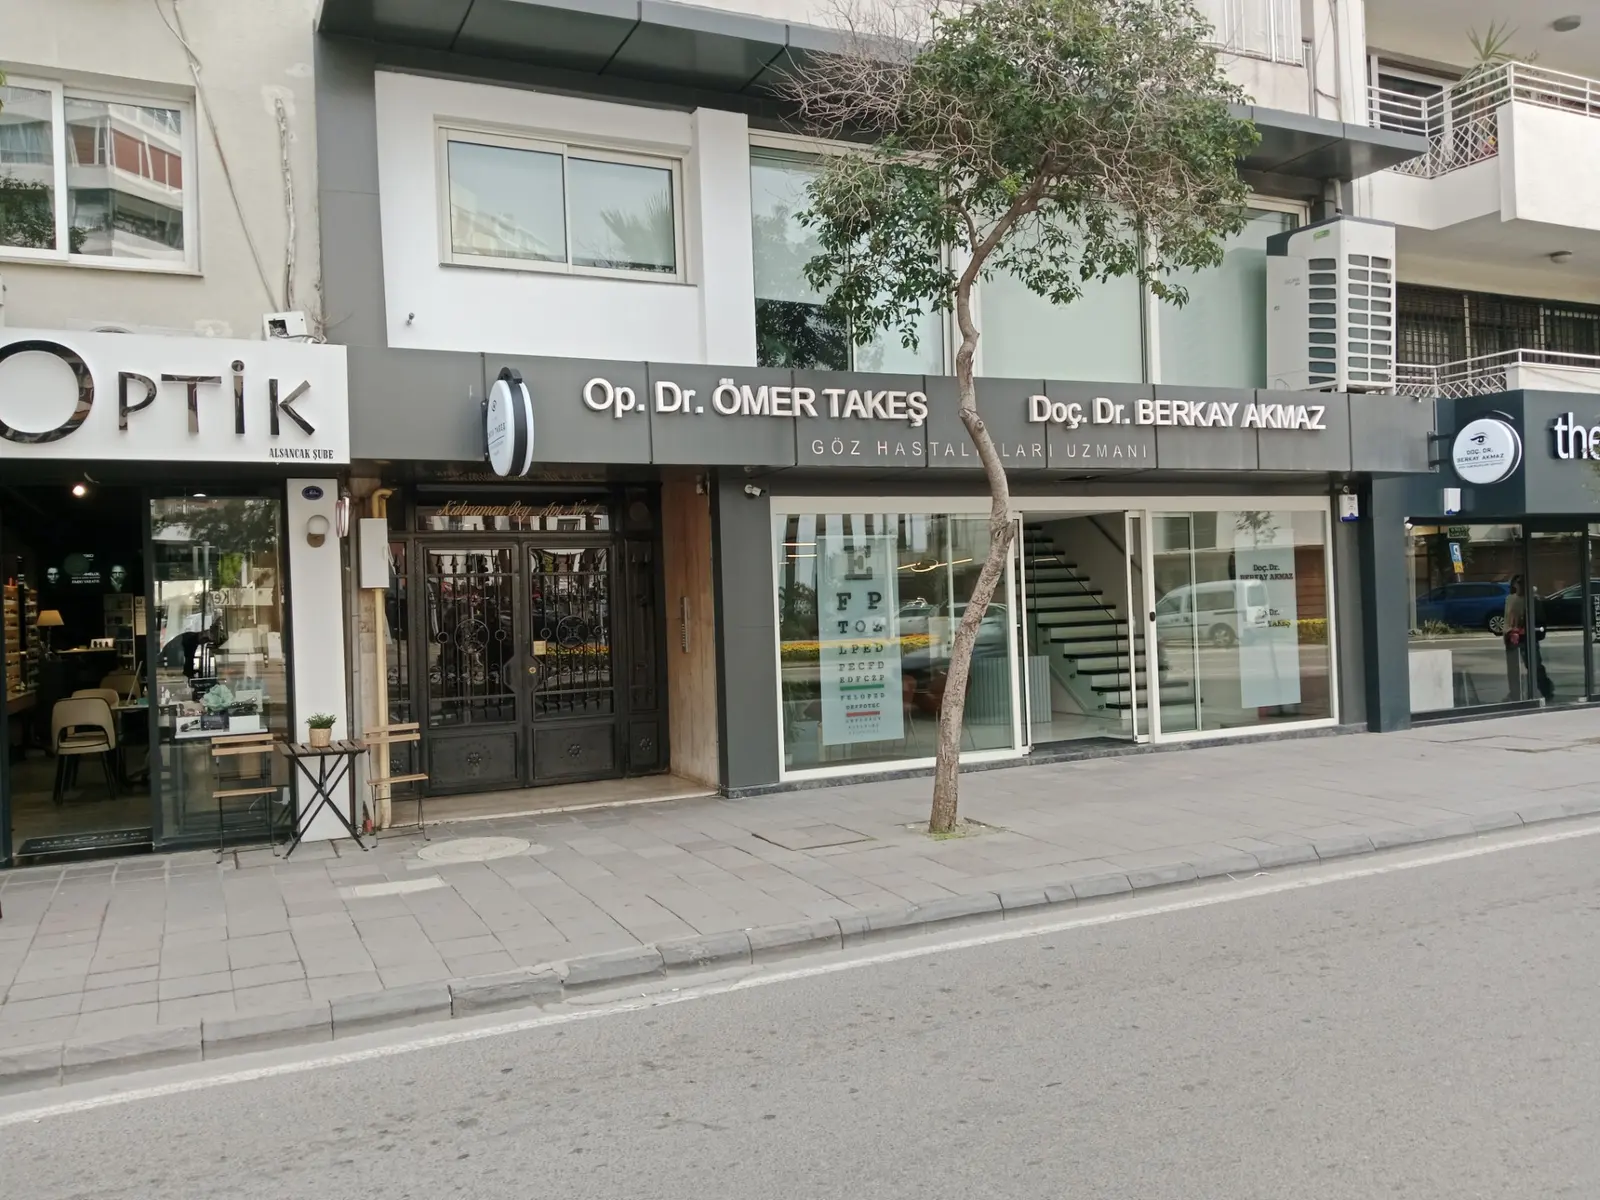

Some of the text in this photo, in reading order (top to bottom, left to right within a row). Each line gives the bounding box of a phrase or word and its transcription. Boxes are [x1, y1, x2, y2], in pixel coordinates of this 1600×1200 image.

[583, 377, 929, 427] Op. Dr. ÖMER TAKEŞ
[1028, 394, 1327, 430] Doç. Dr. BERKAY AKMAZ
[811, 437, 1148, 459] GÖZ HASTALLARI UZMANI
[1553, 411, 1600, 460] the
[269, 448, 334, 461] ALSANCAK ŞUBE
[436, 500, 506, 516] Kahraman
[506, 500, 533, 521] Bey
[843, 545, 873, 580] E
